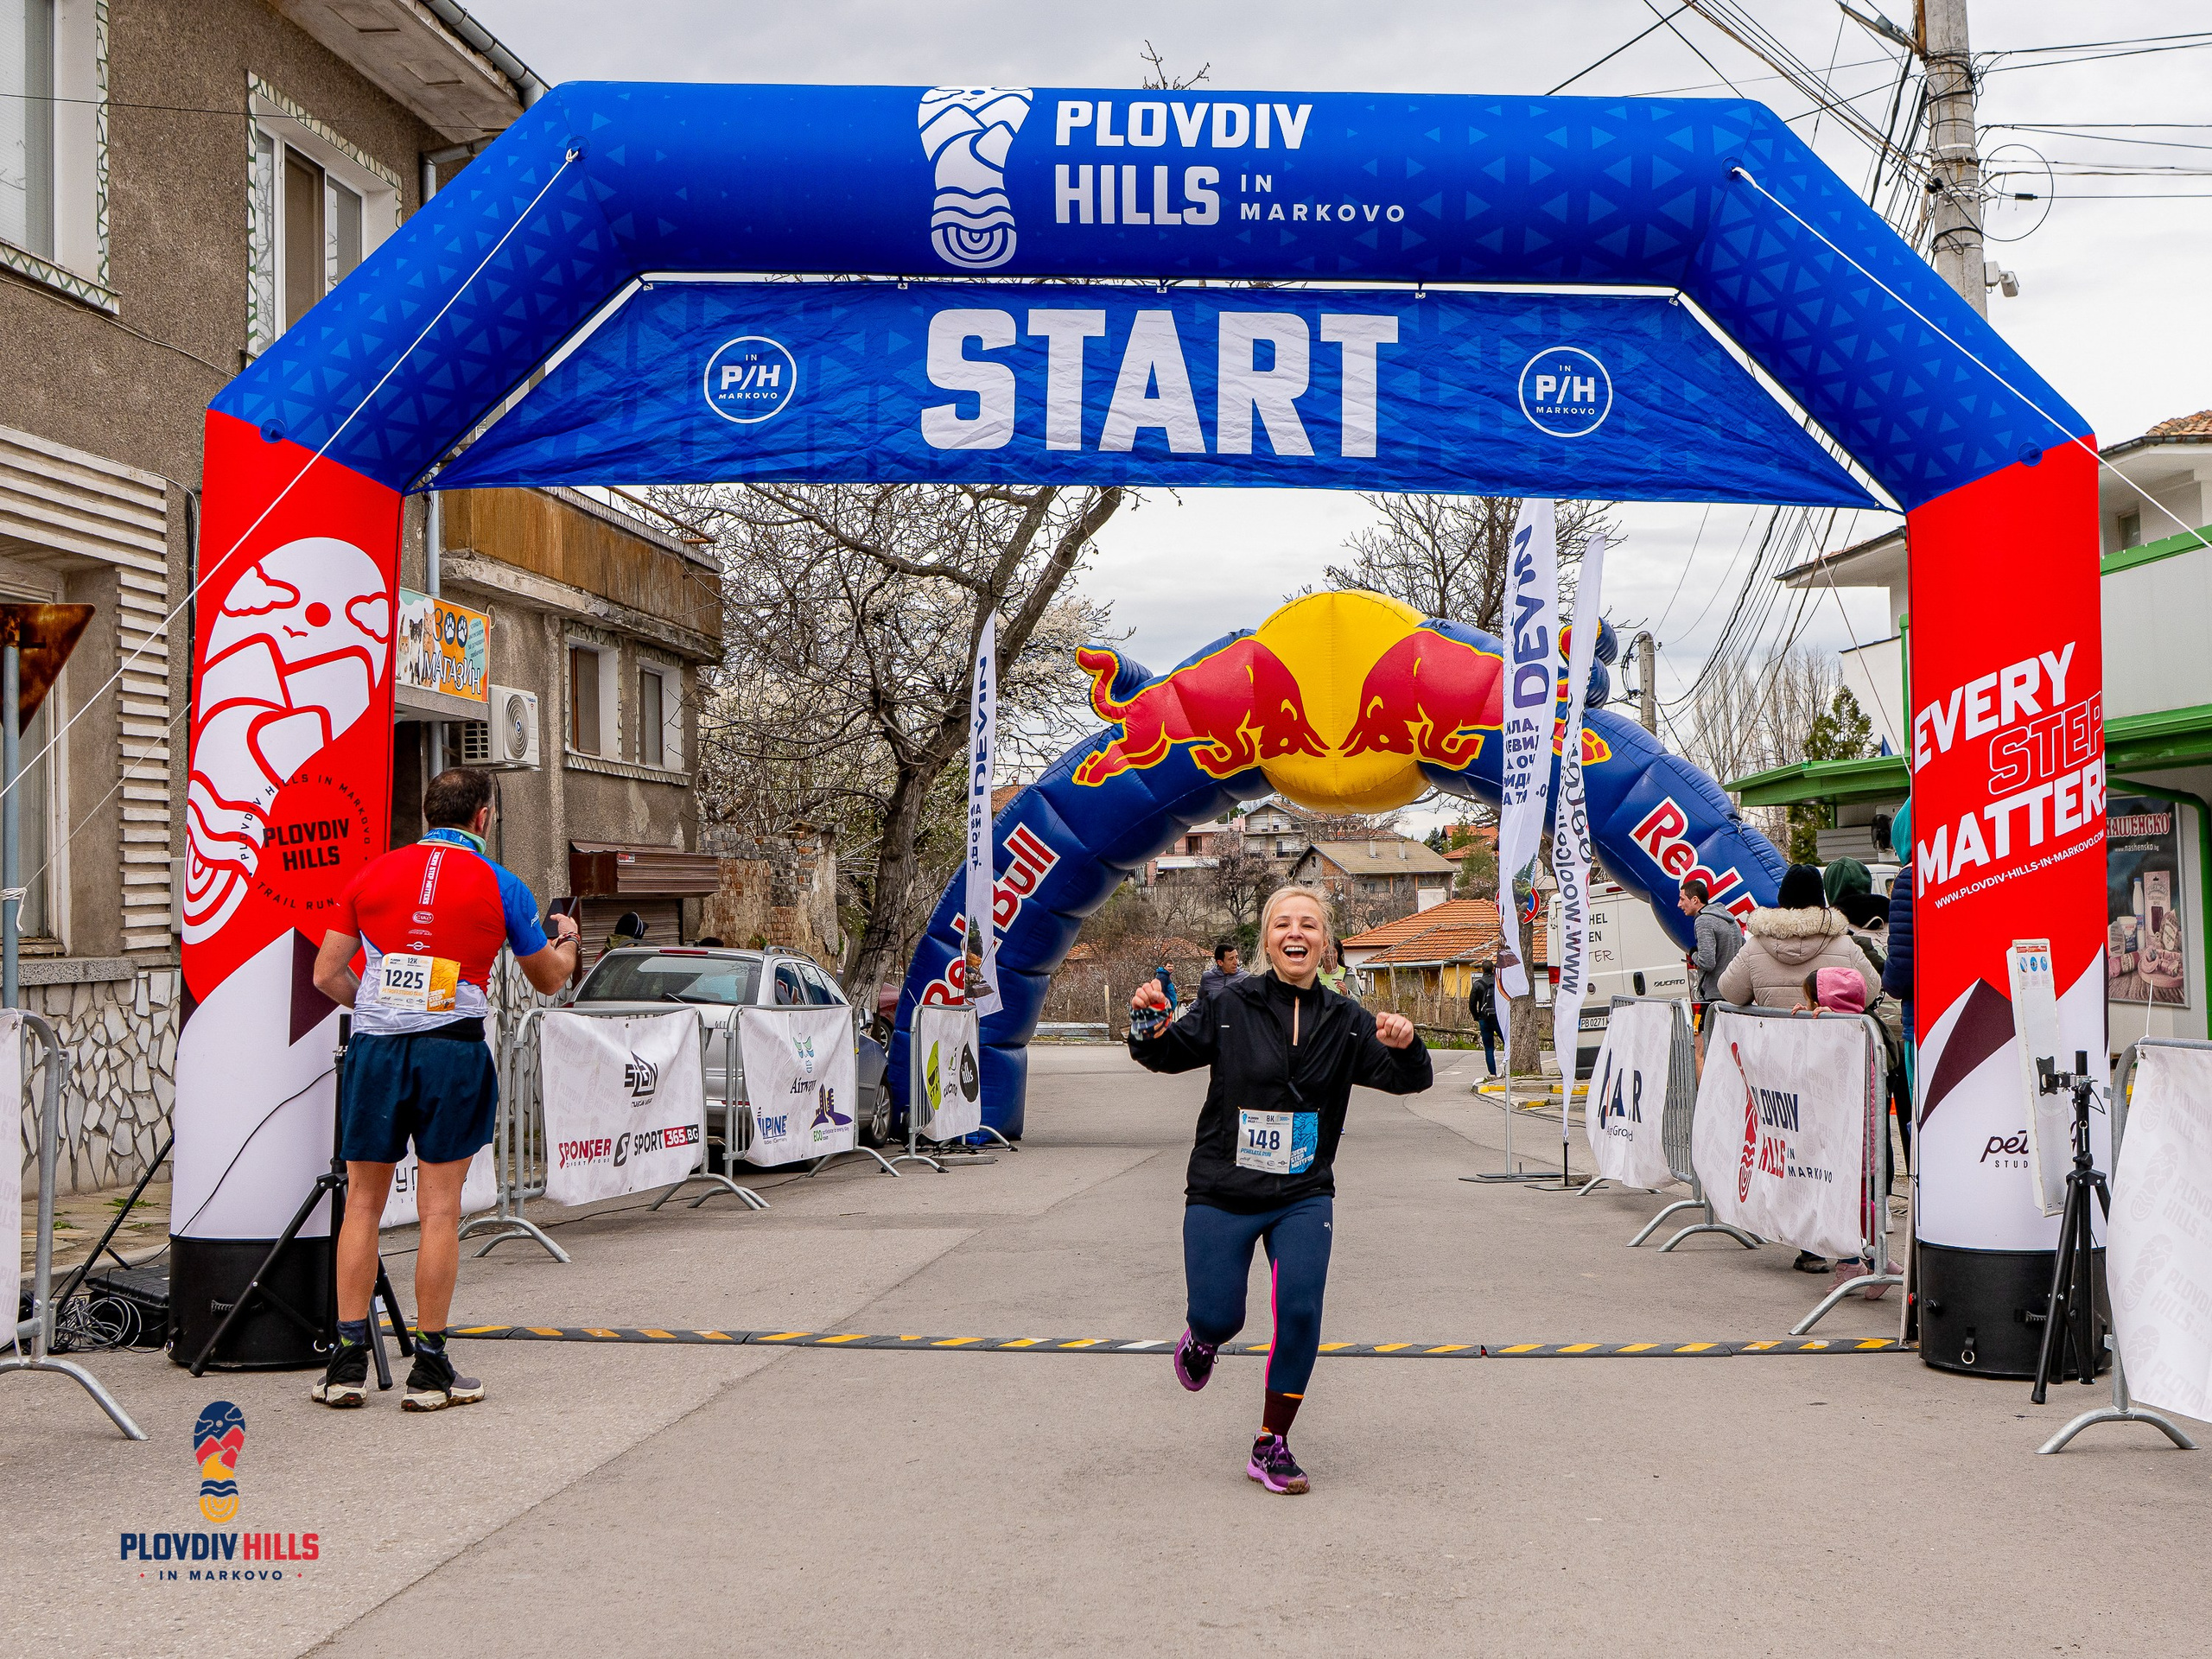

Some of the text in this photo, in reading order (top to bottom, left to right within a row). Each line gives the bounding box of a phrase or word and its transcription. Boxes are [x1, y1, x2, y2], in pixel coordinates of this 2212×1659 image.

[1055, 99, 1313, 149] PLOVDIV
[1055, 163, 1220, 226] HILLS
[1240, 174, 1273, 193] IN
[1240, 202, 1405, 222] MARKOVO
[721, 365, 781, 391] P/H
[920, 308, 1399, 458] START
[1535, 375, 1595, 404] P/H
[1535, 406, 1595, 415] MARKOVO
[423, 651, 481, 695] МАГАЗИН
[1914, 640, 2075, 774] EVERY
[974, 656, 987, 796] DEVIN
[1988, 690, 2102, 796] STEP
[239, 773, 371, 861] PLOVDIV HILLS IN MARKOVO
[2106, 812, 2171, 837] НАШЕНСКО
[263, 818, 349, 848] PLOVDIV
[282, 845, 340, 871] HILLS
[1632, 799, 1740, 900] Red
[1934, 828, 2105, 909] WWW.PLOVDIV-HILLS-IN-MARKOVO.COM
[257, 881, 335, 910] TRAIL RUN
[385, 969, 424, 989] 1225
[558, 1138, 612, 1169] SPONSER
[1248, 1128, 1281, 1150] 148
[1787, 1147, 1796, 1160] IN
